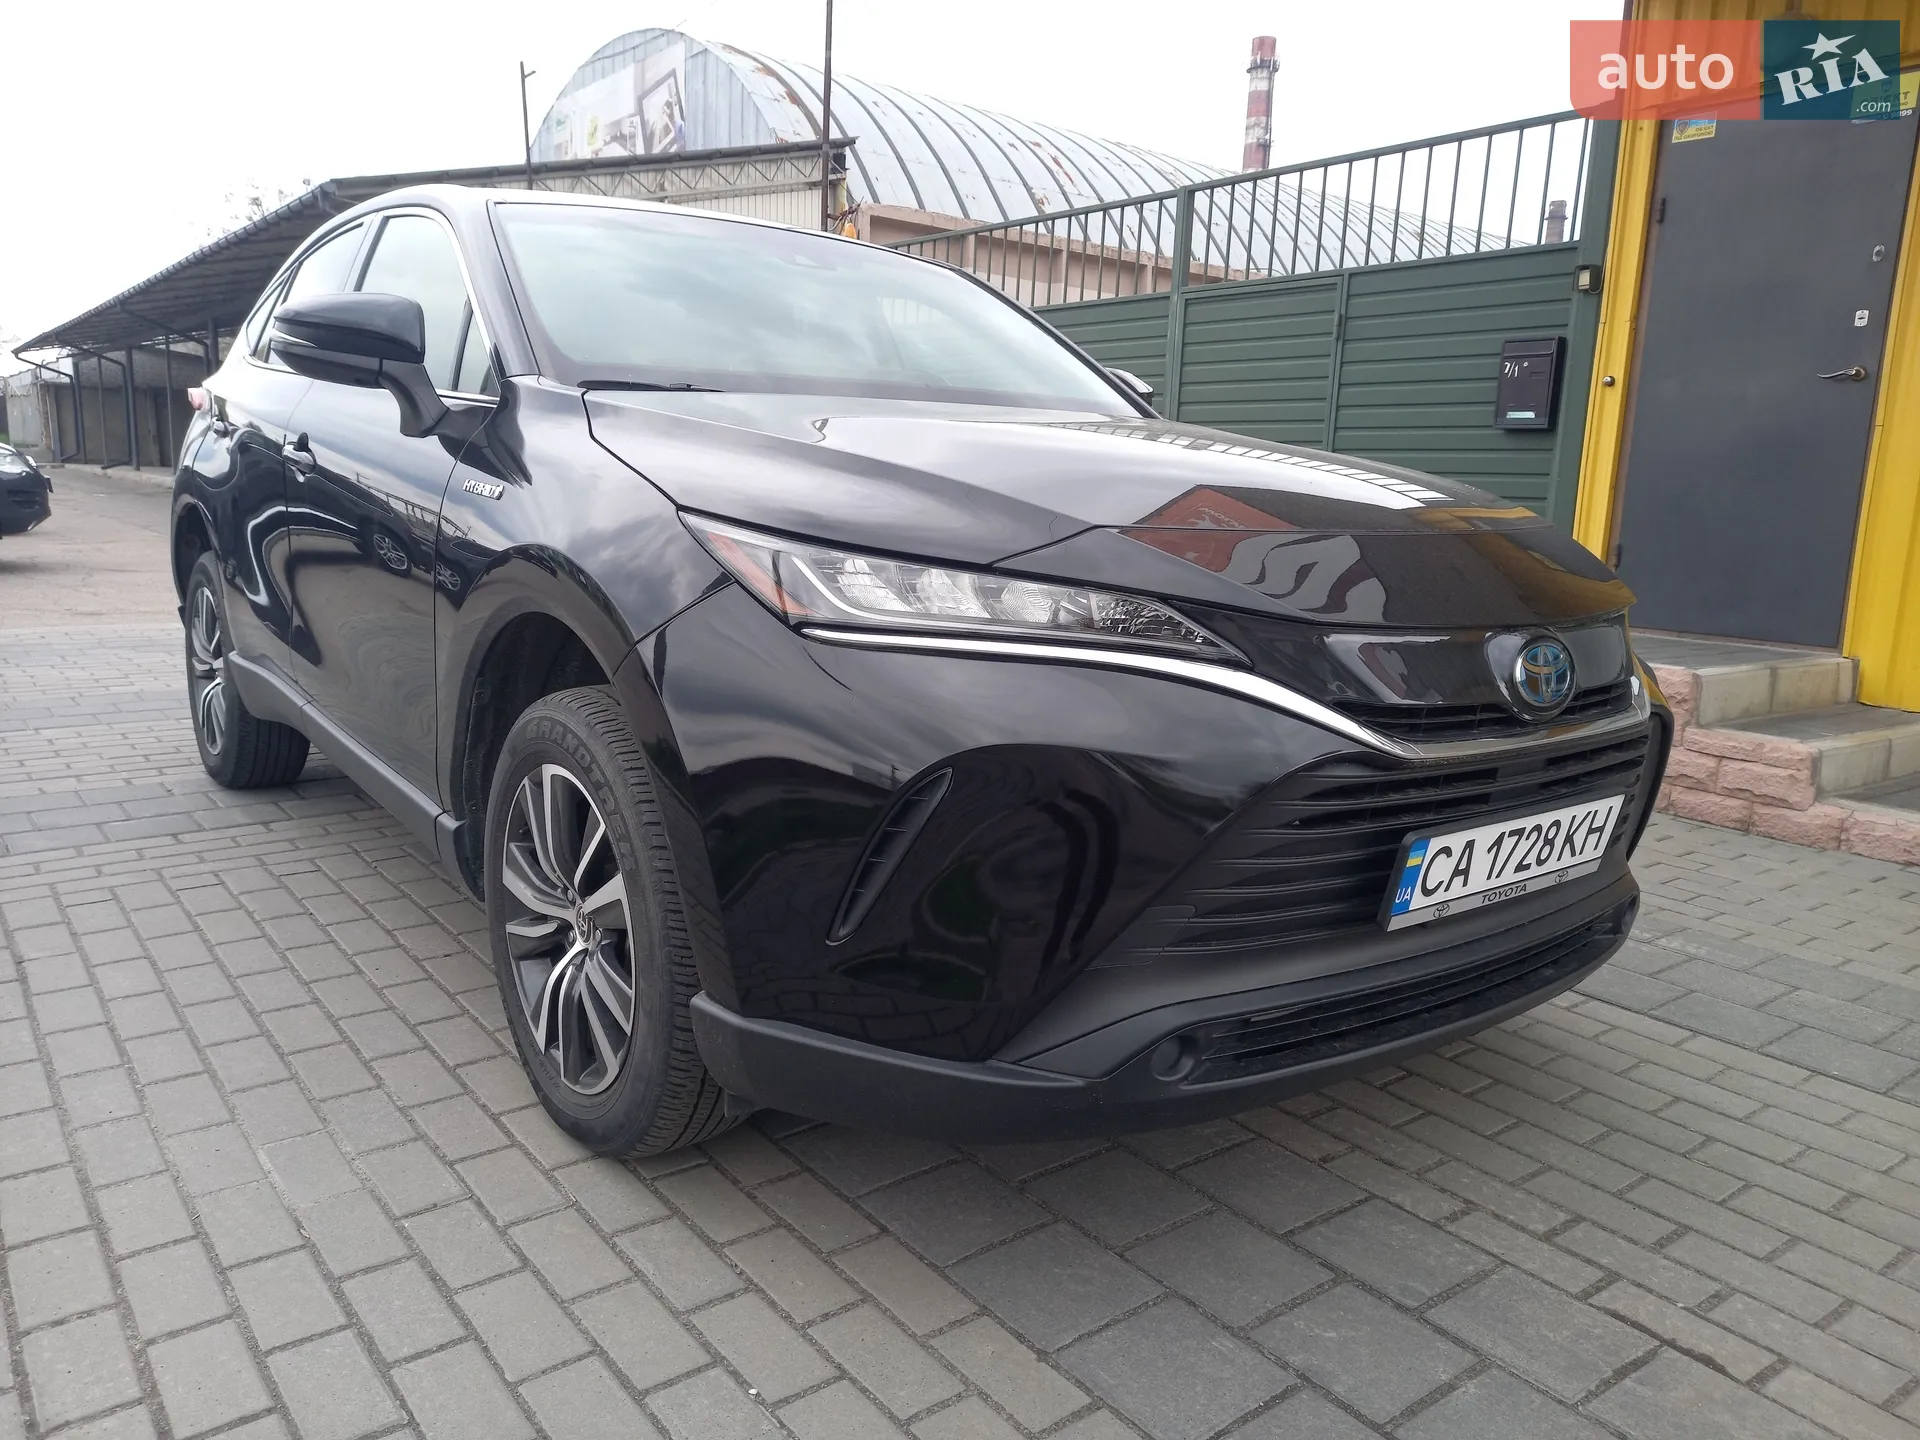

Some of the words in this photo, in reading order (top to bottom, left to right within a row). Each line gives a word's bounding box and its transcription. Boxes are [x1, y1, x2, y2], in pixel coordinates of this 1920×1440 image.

[1420, 839, 1476, 897] CA
[1395, 886, 1411, 904] UA
[1481, 884, 1527, 904] TOYOTA
